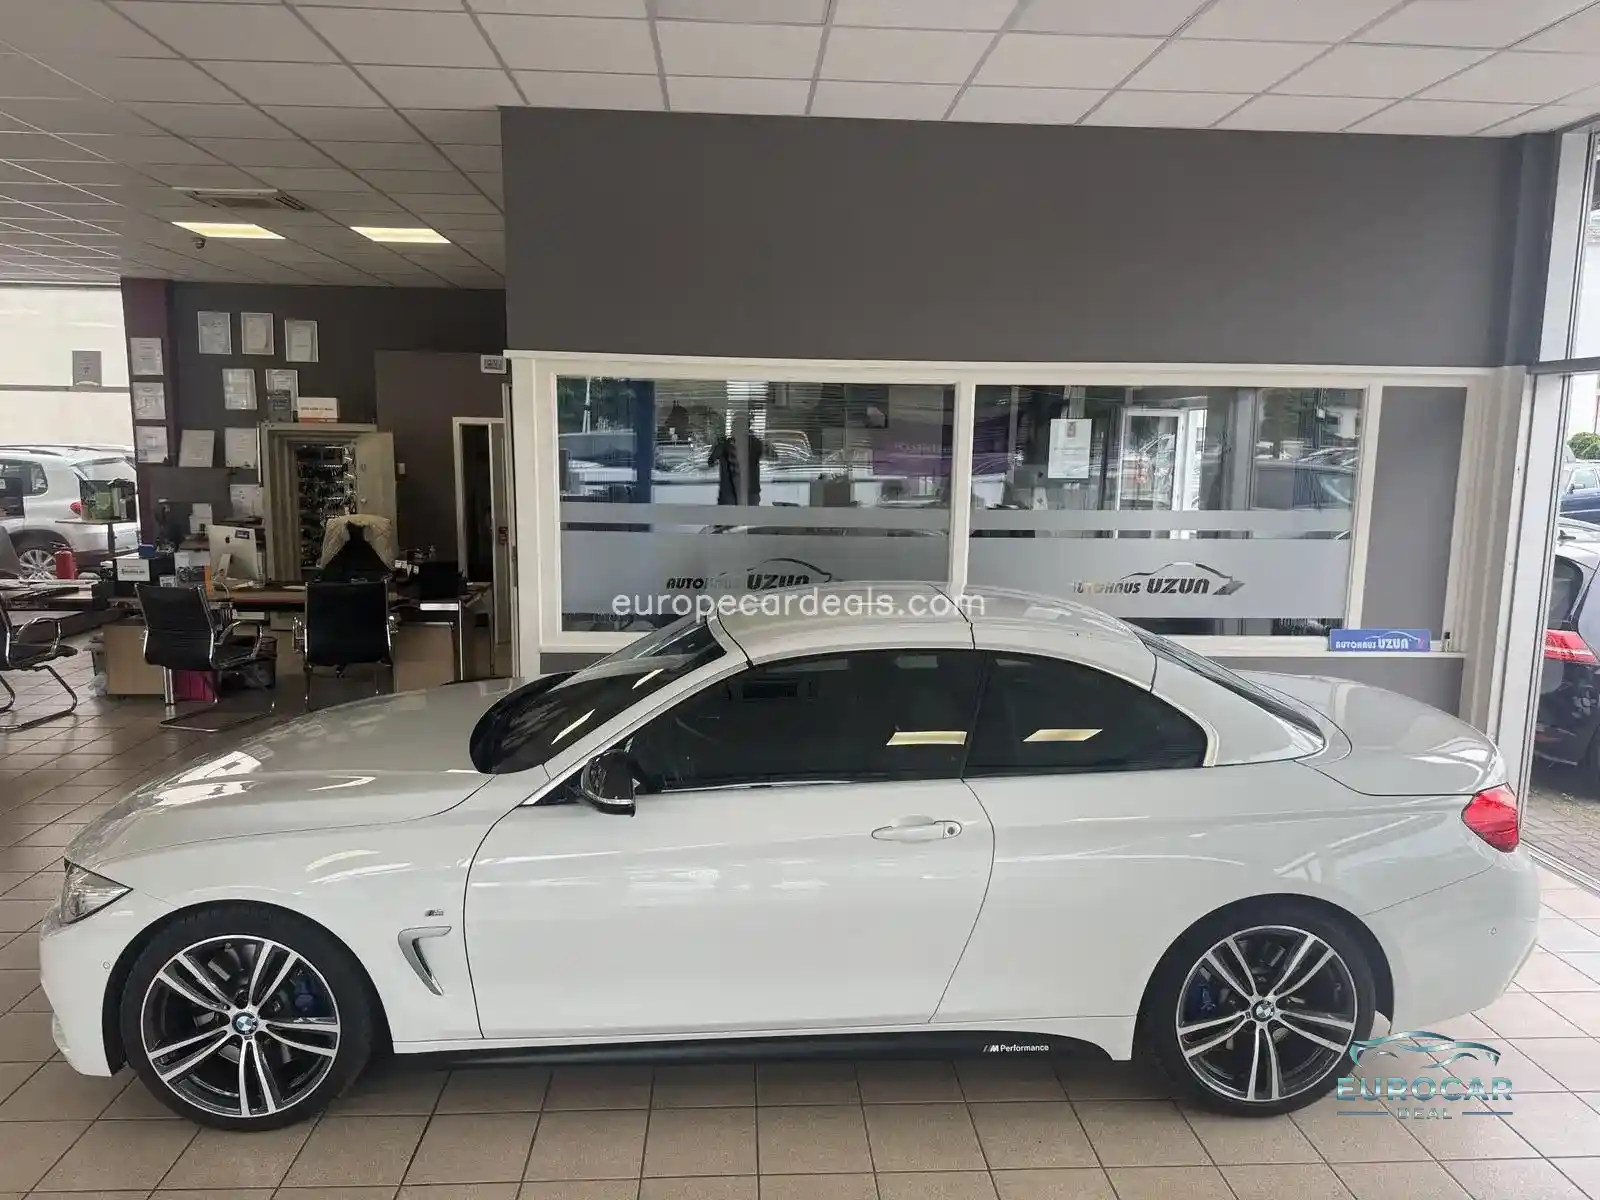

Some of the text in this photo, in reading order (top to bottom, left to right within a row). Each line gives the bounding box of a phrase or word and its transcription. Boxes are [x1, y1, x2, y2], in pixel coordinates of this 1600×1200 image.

[666, 577, 740, 590] AUTOH
[1146, 577, 1210, 594] UZUN
[1335, 638, 1409, 649] AUTOHAUS UZUN
[1000, 1044, 1050, 1052] Performance
